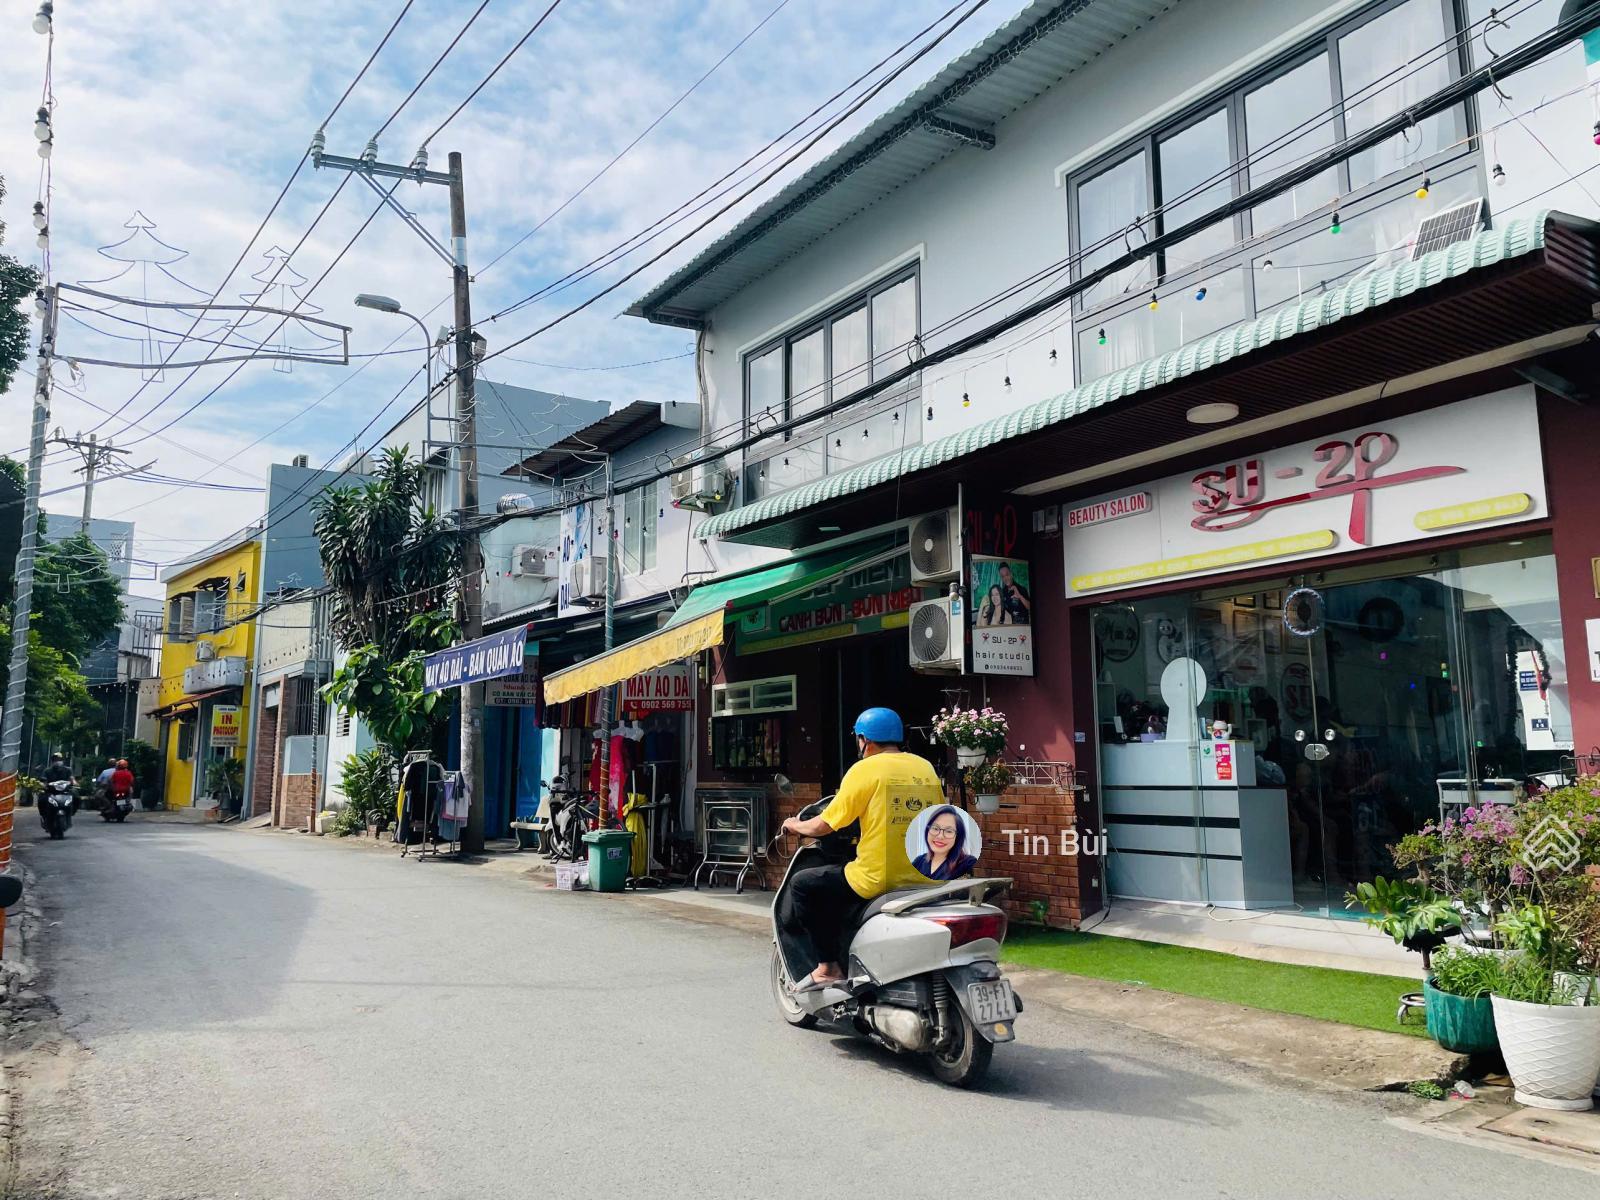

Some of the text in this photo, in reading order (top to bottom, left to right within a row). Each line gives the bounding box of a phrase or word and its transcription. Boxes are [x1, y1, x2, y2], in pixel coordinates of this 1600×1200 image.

[1191, 459, 1265, 514] SU
[1069, 493, 1145, 526] BEAUTY SALON
[779, 609, 813, 632] CANH
[992, 636, 1002, 644] SU
[425, 663, 440, 688] MAY
[439, 657, 449, 684] ÁO
[450, 652, 464, 682] DÀI
[469, 645, 486, 677] BÁN
[510, 636, 524, 668] ÁO
[975, 650, 1031, 661] hair studio
[626, 675, 652, 697] MAY
[654, 669, 670, 698] ÁO
[641, 700, 660, 709] 0902
[662, 700, 676, 709] 569
[974, 982, 1006, 1003] 39-F1
